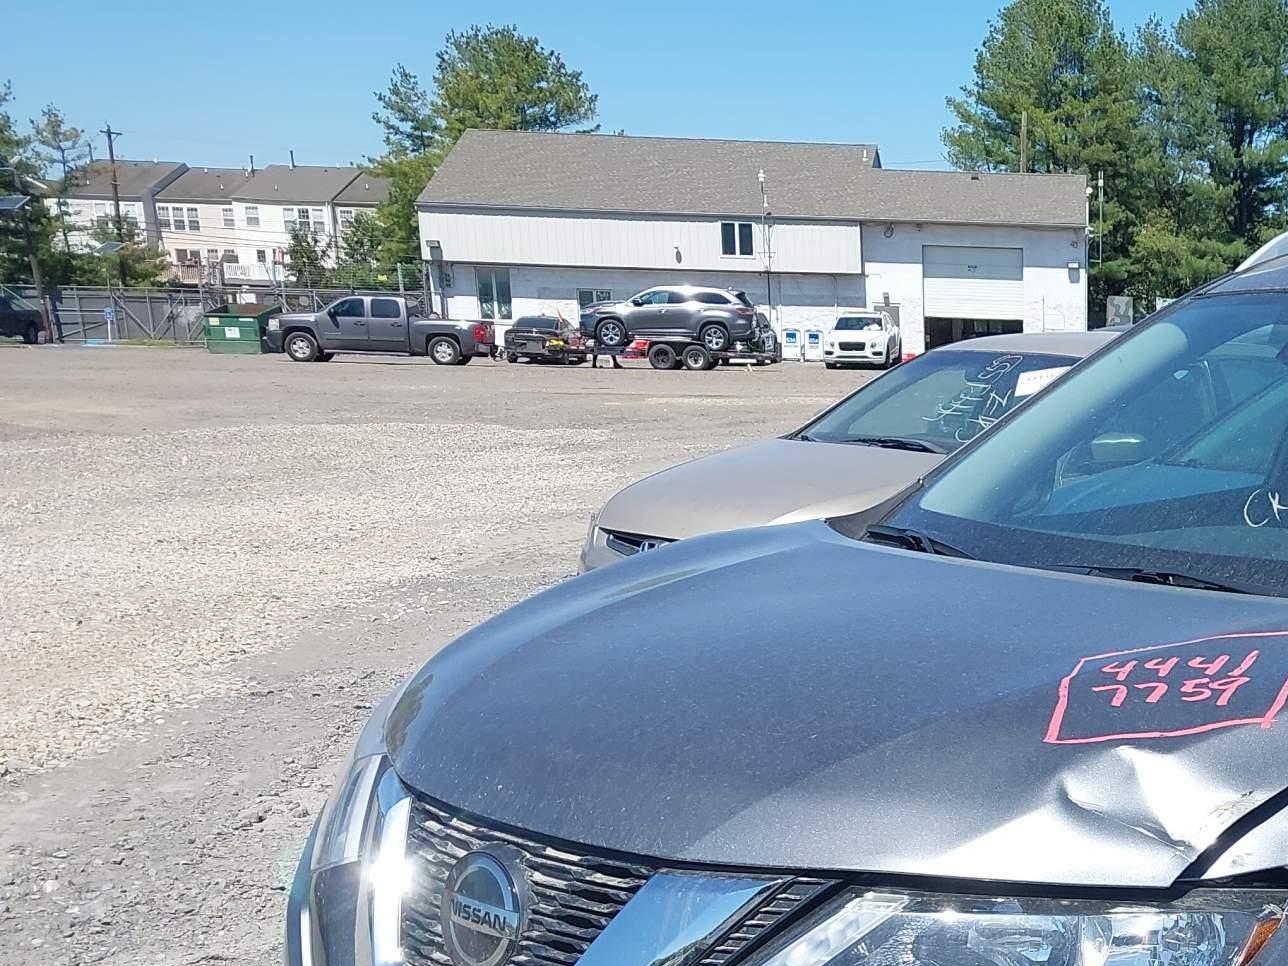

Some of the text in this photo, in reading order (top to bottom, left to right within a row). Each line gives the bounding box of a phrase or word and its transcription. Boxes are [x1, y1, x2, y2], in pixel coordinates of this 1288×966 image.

[1101, 649, 1260, 682] 4441
[1091, 676, 1251, 707] 7759
[450, 898, 507, 932] NISSAN
